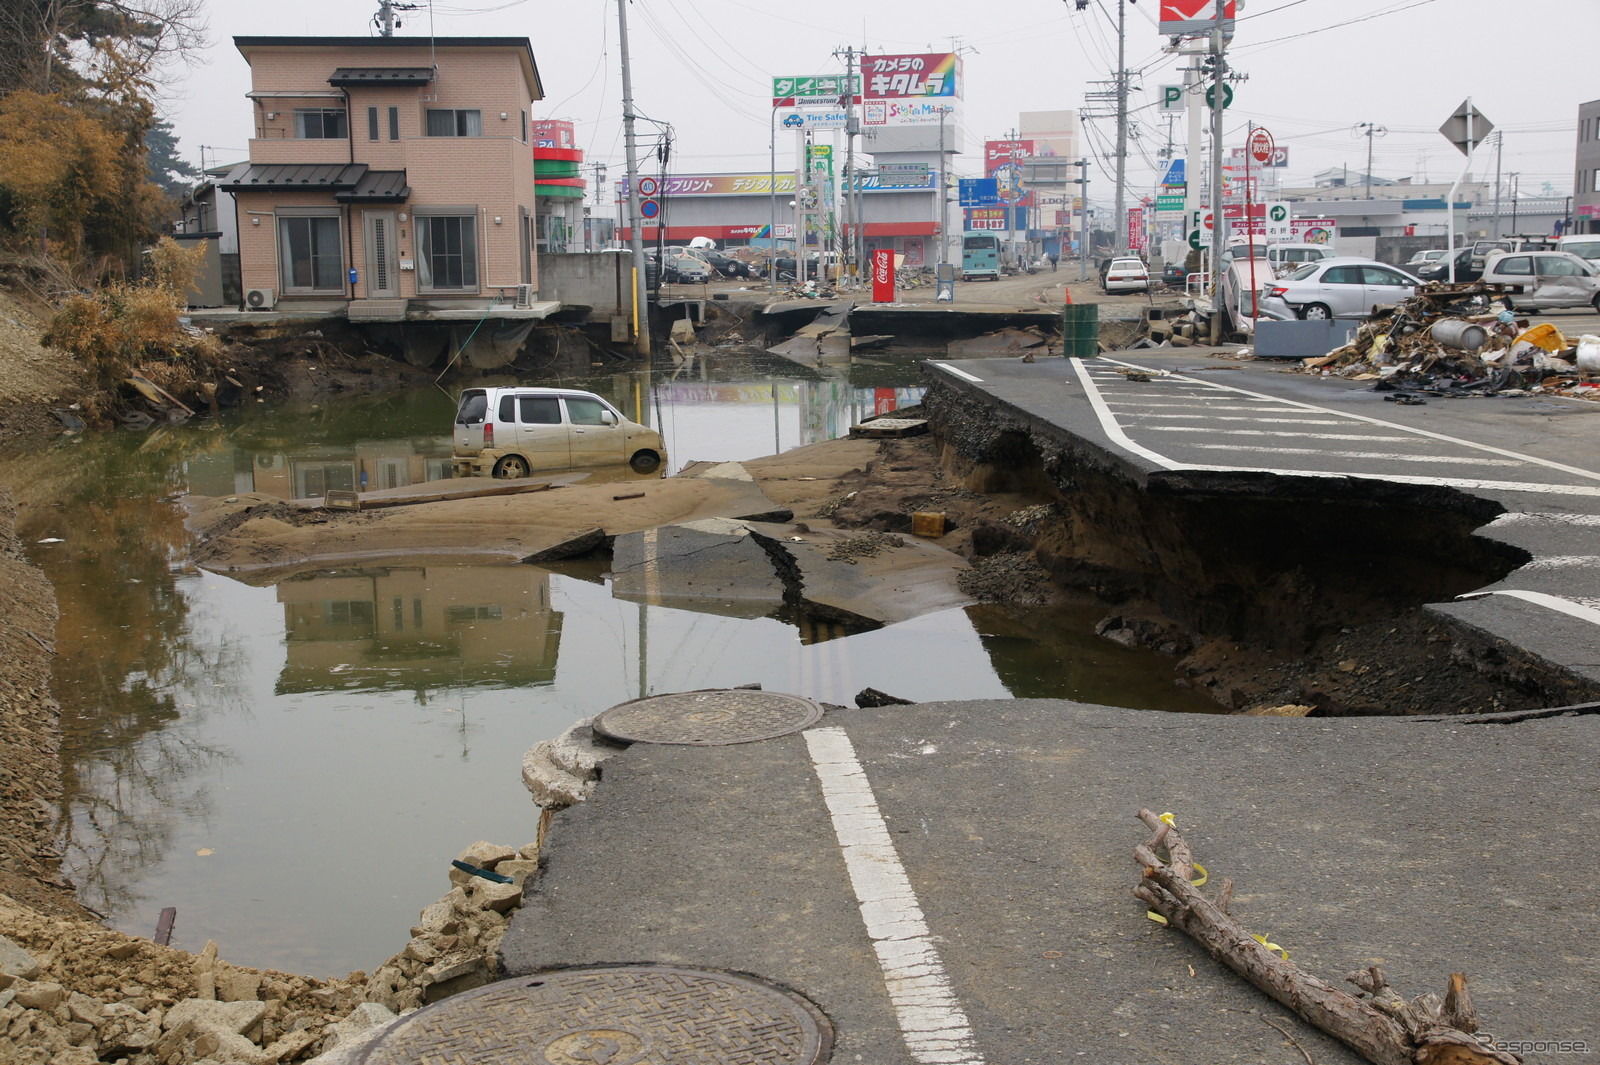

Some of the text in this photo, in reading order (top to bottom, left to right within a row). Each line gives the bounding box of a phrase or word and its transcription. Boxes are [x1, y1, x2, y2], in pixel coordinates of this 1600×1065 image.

[873, 58, 925, 73] カメラの
[870, 73, 946, 96] キタムラ
[1165, 87, 1182, 108] P
[825, 113, 849, 121] Safet
[643, 183, 654, 191] 40
[877, 251, 888, 284] Coca-Cola
